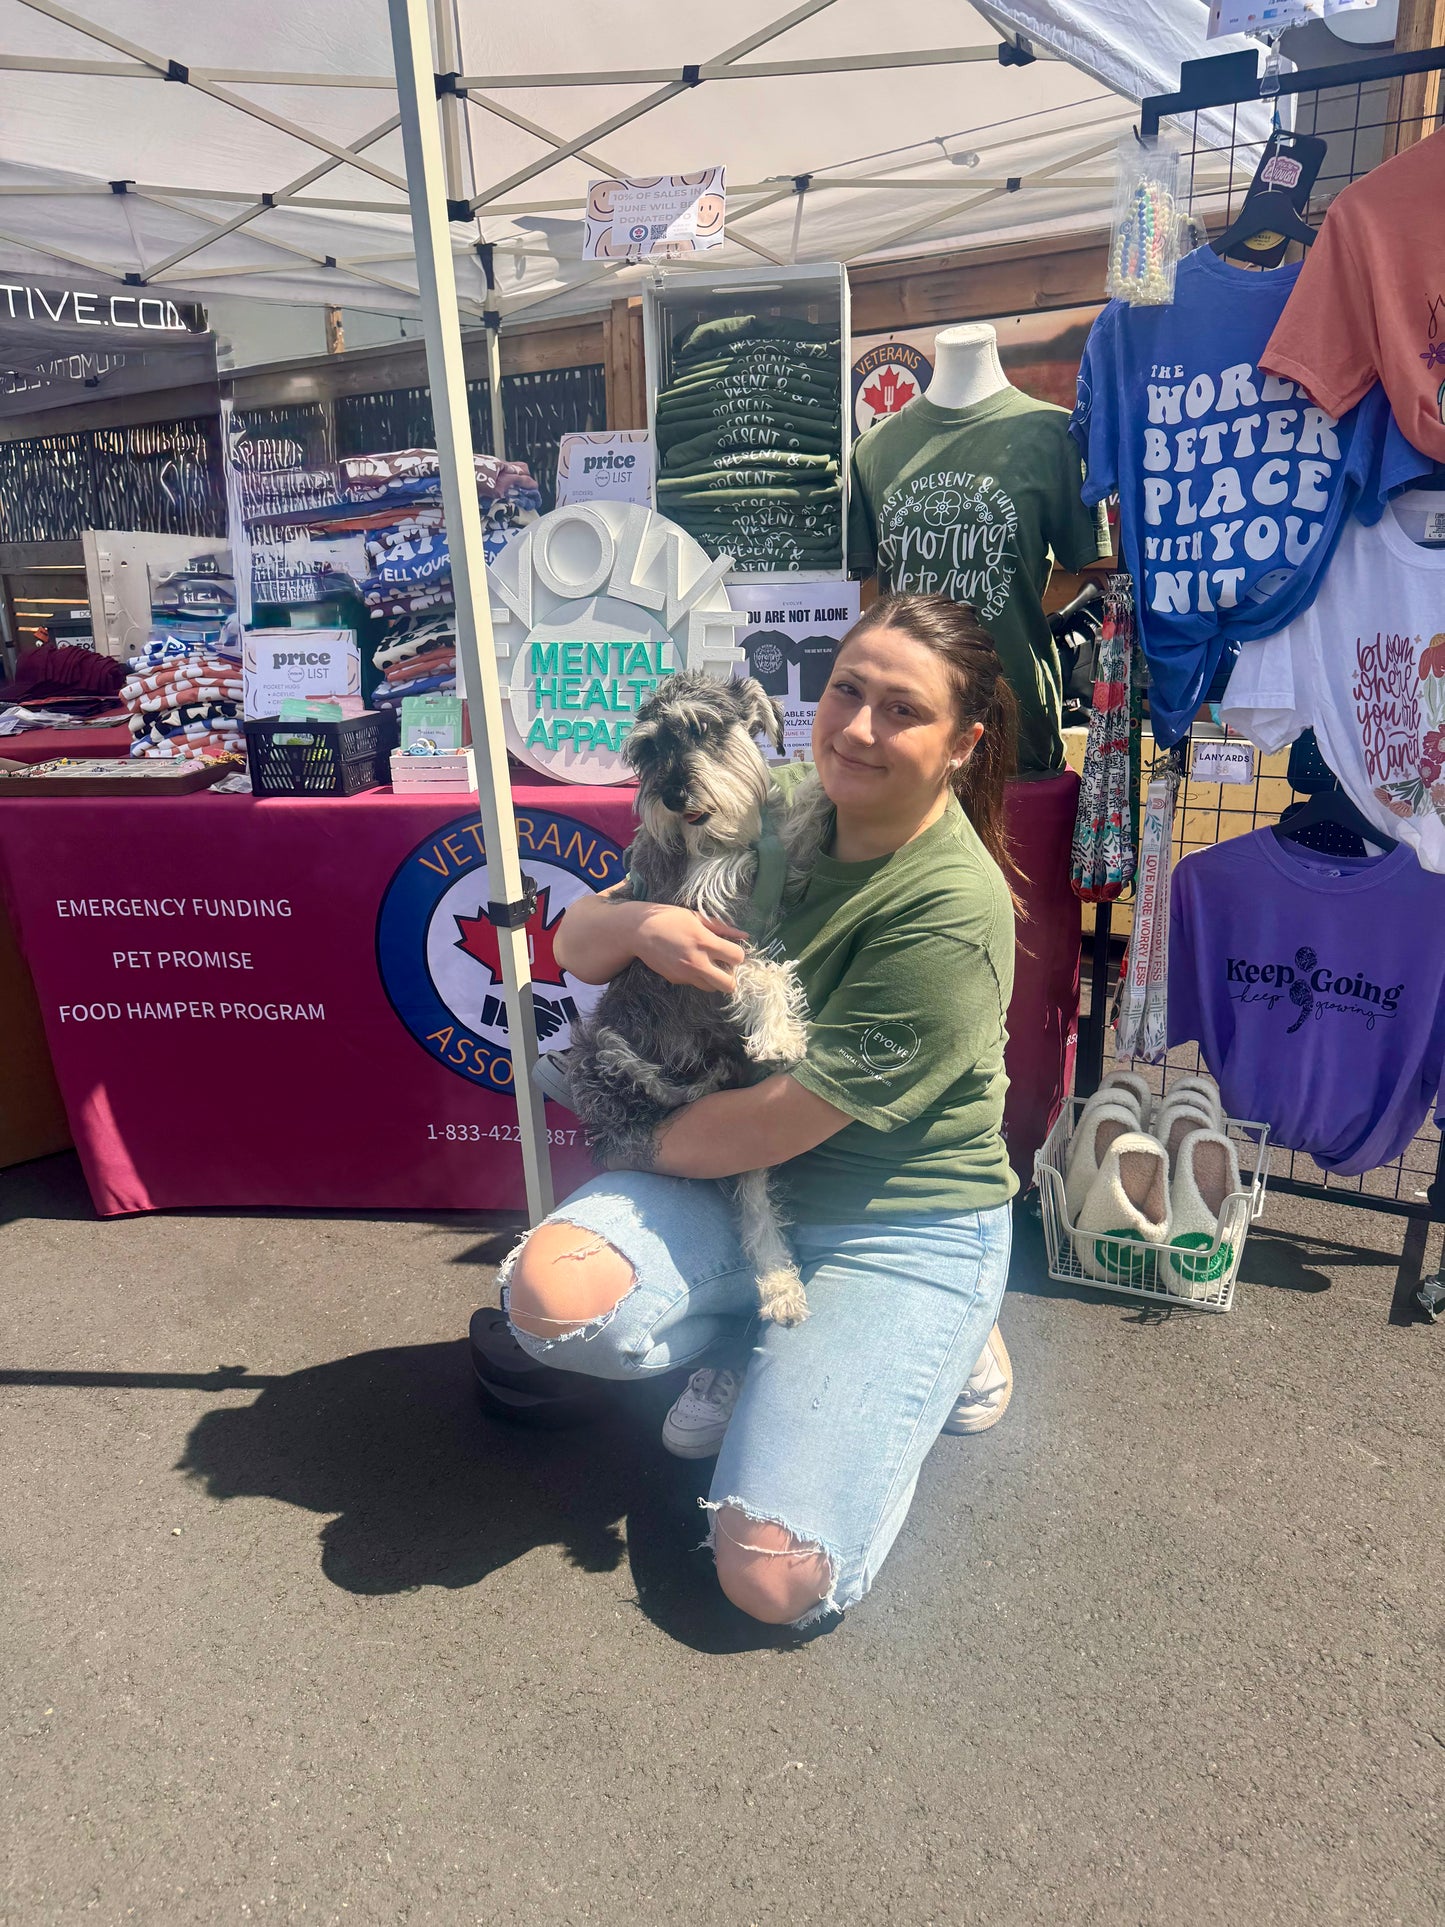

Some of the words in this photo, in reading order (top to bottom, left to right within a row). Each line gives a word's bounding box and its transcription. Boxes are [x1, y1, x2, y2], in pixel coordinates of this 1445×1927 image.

[614, 192, 634, 201] 10%
[636, 191, 650, 200] OF
[653, 188, 688, 199] SALES
[690, 187, 701, 196] IN
[618, 204, 646, 213] JUNE
[649, 202, 676, 211] WILL
[620, 213, 673, 224] DONATED
[855, 346, 922, 377] VETERANS
[1151, 364, 1184, 379] THE
[1147, 363, 1313, 425] WORL
[717, 427, 780, 449] PRESENT
[1143, 407, 1342, 472] BETTER
[583, 450, 636, 474] price
[612, 471, 633, 483] LIST
[1143, 458, 1331, 526] PLACE
[911, 471, 976, 494] PRESENT,
[978, 476, 994, 494] &
[990, 488, 1019, 543] FUTURE
[1145, 531, 1203, 562] WITH
[1210, 515, 1324, 566] YOU
[413, 555, 450, 578] YOUR
[485, 505, 749, 700] VOLVE
[981, 566, 1016, 621] SERVICE
[748, 611, 761, 624] OU
[765, 610, 785, 623] ARE
[789, 609, 810, 623] NOT
[814, 607, 849, 622] ALONE
[272, 651, 331, 670] price
[531, 641, 676, 676] MENTAL
[307, 667, 329, 680] LIST
[525, 717, 635, 753] APPAR
[1357, 702, 1402, 747] you
[1199, 753, 1250, 763] LANYARDS
[1364, 726, 1421, 785] planed
[418, 817, 618, 879] VETRANS
[1145, 854, 1158, 882] LOVE
[56, 898, 186, 917] EMERGENCY
[192, 898, 292, 917] FUNDING
[1142, 884, 1154, 916] MORE
[1138, 918, 1151, 958] WORRY
[112, 951, 151, 969] PET
[158, 950, 254, 970] PROMISE
[1136, 960, 1147, 987] LESS
[1226, 958, 1295, 988] Keep
[1311, 968, 1405, 1011] Going
[59, 1003, 121, 1022] FOOD
[127, 1002, 216, 1020] HAMPER
[220, 1003, 325, 1021] PROGRAM
[1230, 984, 1285, 1010] keep
[1315, 999, 1398, 1031] growing
[426, 1026, 514, 1085] ASSO
[873, 1032, 909, 1059] EVOLVE
